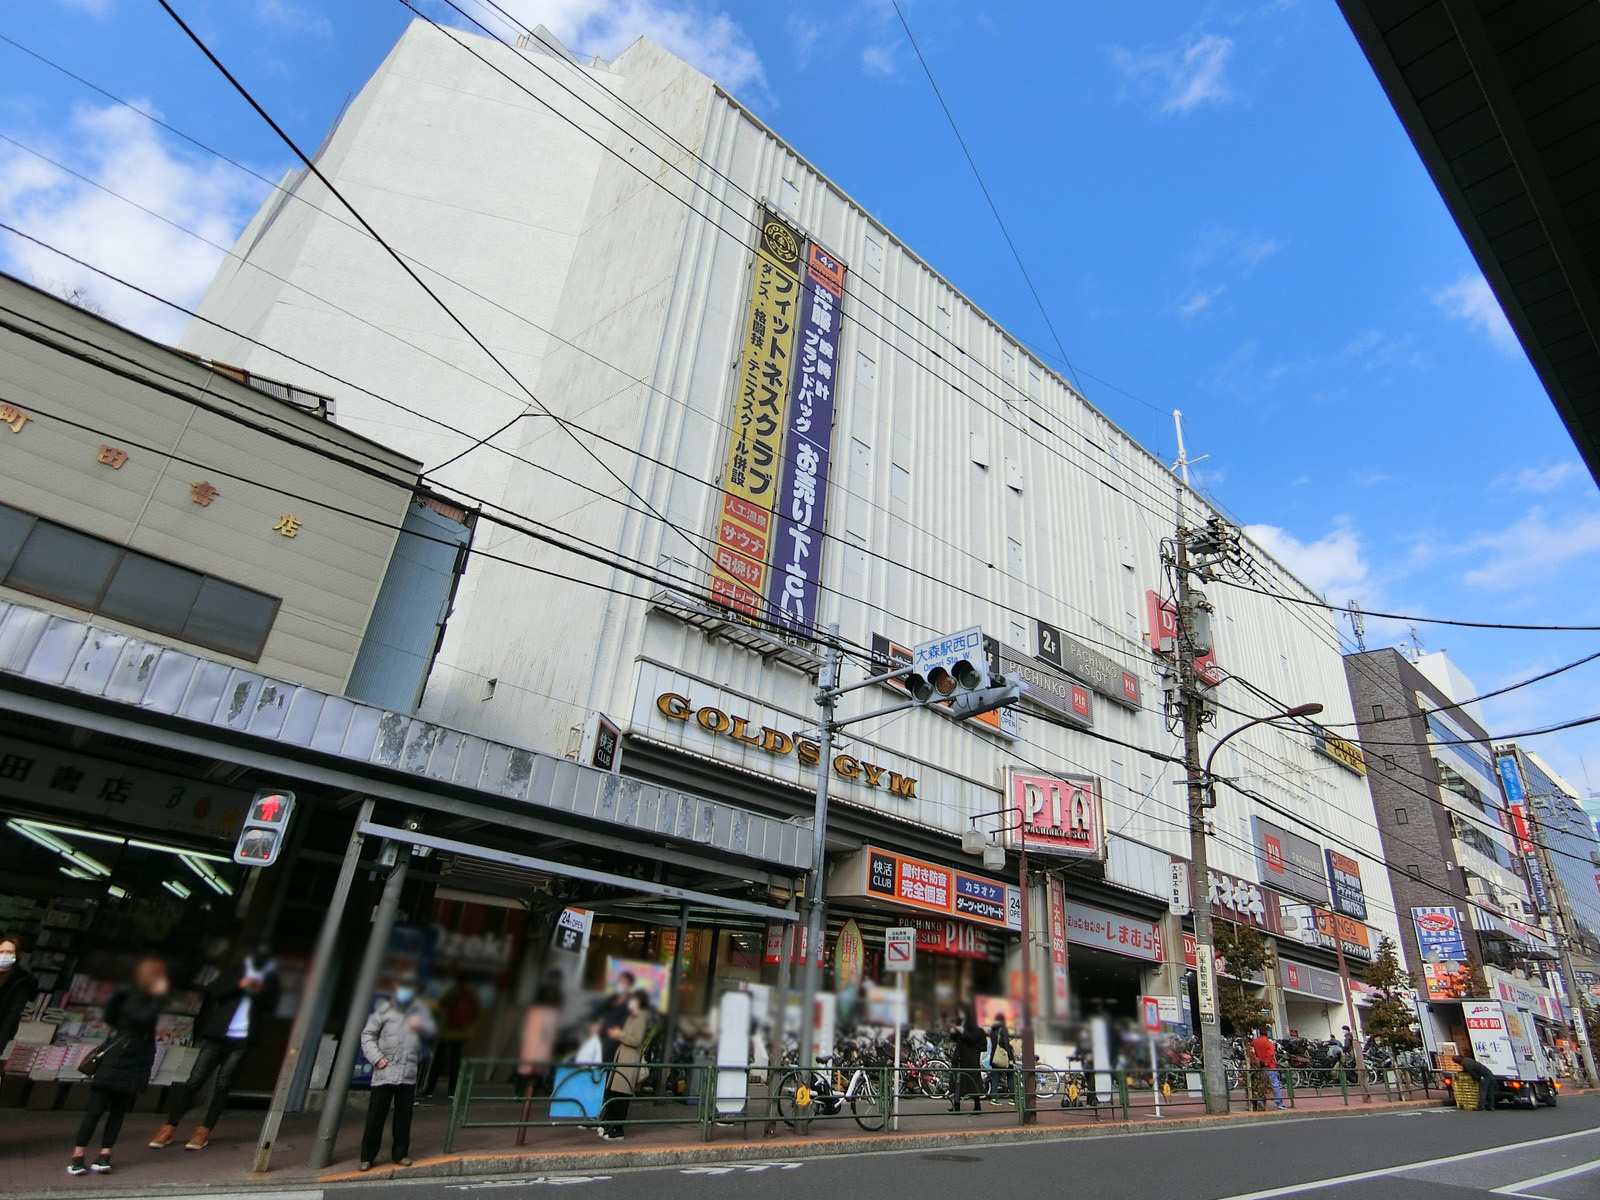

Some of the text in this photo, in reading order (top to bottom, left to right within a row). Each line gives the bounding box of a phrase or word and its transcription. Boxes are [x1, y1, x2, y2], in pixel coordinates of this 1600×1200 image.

[731, 262, 774, 488] ダンス・格闘技・テニススクール併設
[749, 270, 794, 495] フィットネスクラブ
[795, 329, 820, 432] ブランドバッグ
[726, 500, 767, 528] 人工温泉
[723, 525, 764, 553] サウナ
[780, 443, 819, 622] お売り下さい
[719, 553, 760, 583] 日焼け
[714, 581, 758, 608] ショップ
[916, 632, 979, 665] 大森駅西口
[1042, 630, 1056, 654] 2F
[1070, 644, 1117, 678] PACHINKO
[1009, 661, 1066, 699] PACHINKO
[1125, 679, 1135, 692] PIA
[1074, 692, 1086, 708] PIA
[656, 692, 820, 766] GOLD'S
[1001, 716, 1016, 728] OPEN
[600, 732, 614, 754] 快活
[597, 749, 611, 767] CLUB
[833, 754, 918, 798] GYM
[1022, 779, 1090, 831] PIA
[1025, 824, 1065, 837] PACHINKO
[1072, 830, 1090, 840] SLOT
[873, 860, 893, 877] 快活
[873, 874, 892, 888] CLUB
[902, 862, 947, 888] 鍵付き防音
[901, 879, 947, 906] 完全個室
[965, 881, 996, 898] カラオケ
[957, 897, 1004, 919] ダーツ・ビリヤード
[1010, 909, 1020, 919] OPE
[572, 918, 585, 930] OPEN
[945, 920, 975, 953] PIA
[1065, 915, 1105, 934] ションセンター
[1107, 920, 1153, 950] しまむら
[1330, 916, 1357, 936] BNGO
[562, 929, 577, 948] 5F
[921, 933, 942, 944] SLOT
[1153, 927, 1162, 958] 4F
[1469, 1019, 1501, 1029] 食材卸
[1475, 1041, 1502, 1053] 麻生
